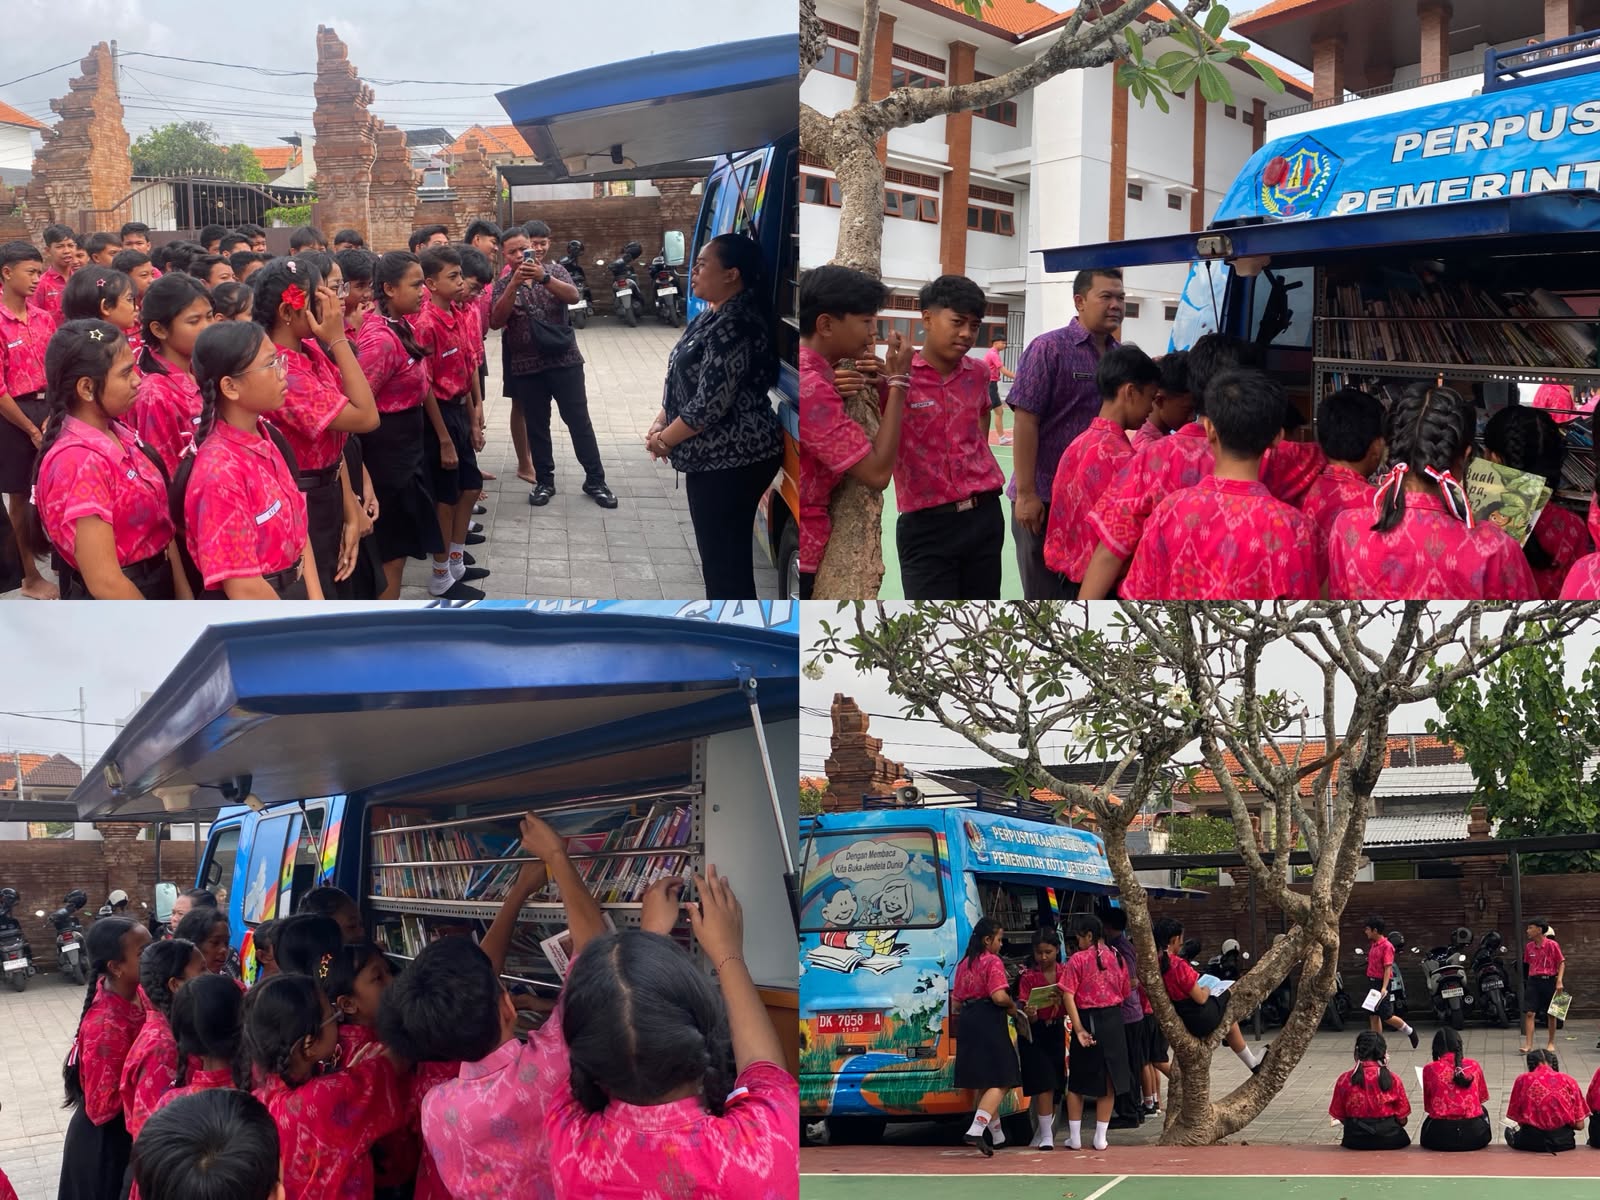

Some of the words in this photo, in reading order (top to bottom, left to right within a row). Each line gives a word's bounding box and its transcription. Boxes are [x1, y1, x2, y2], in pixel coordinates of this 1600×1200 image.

[1391, 100, 1600, 163] PERPUS
[991, 826, 1056, 849] PERPUSTAKAAN
[846, 852, 868, 861] Dengan
[869, 850, 896, 859] Membaca
[991, 851, 1044, 869] PEMERINTAH
[1045, 858, 1065, 872] KOTA
[835, 864, 847, 873] Kita
[848, 863, 862, 872] Buka
[863, 861, 886, 871] Jendela
[887, 861, 904, 869] Dunia
[819, 1015, 833, 1027] DK
[838, 1014, 863, 1026] 7058
[874, 1013, 881, 1025] A
